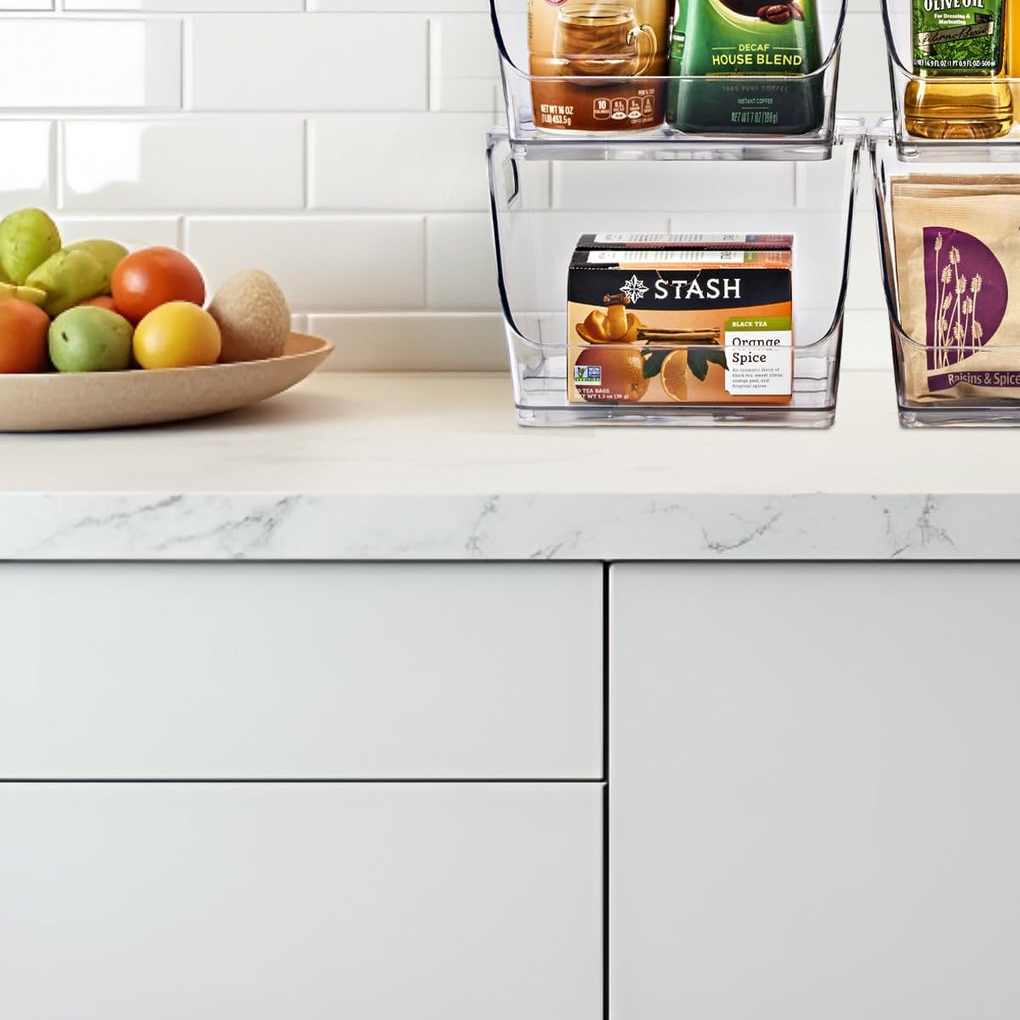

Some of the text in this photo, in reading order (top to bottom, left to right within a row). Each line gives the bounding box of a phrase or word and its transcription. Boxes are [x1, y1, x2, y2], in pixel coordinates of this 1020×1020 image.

[739, 43, 770, 52] DECAF
[712, 54, 802, 66] HOUSE BLEND
[565, 105, 574, 115] OZ
[597, 99, 607, 110] 10
[654, 278, 741, 300] STASH
[732, 337, 781, 348] Orange
[732, 351, 767, 365] Spice
[948, 373, 982, 385] Raisins
[983, 373, 992, 385] &
